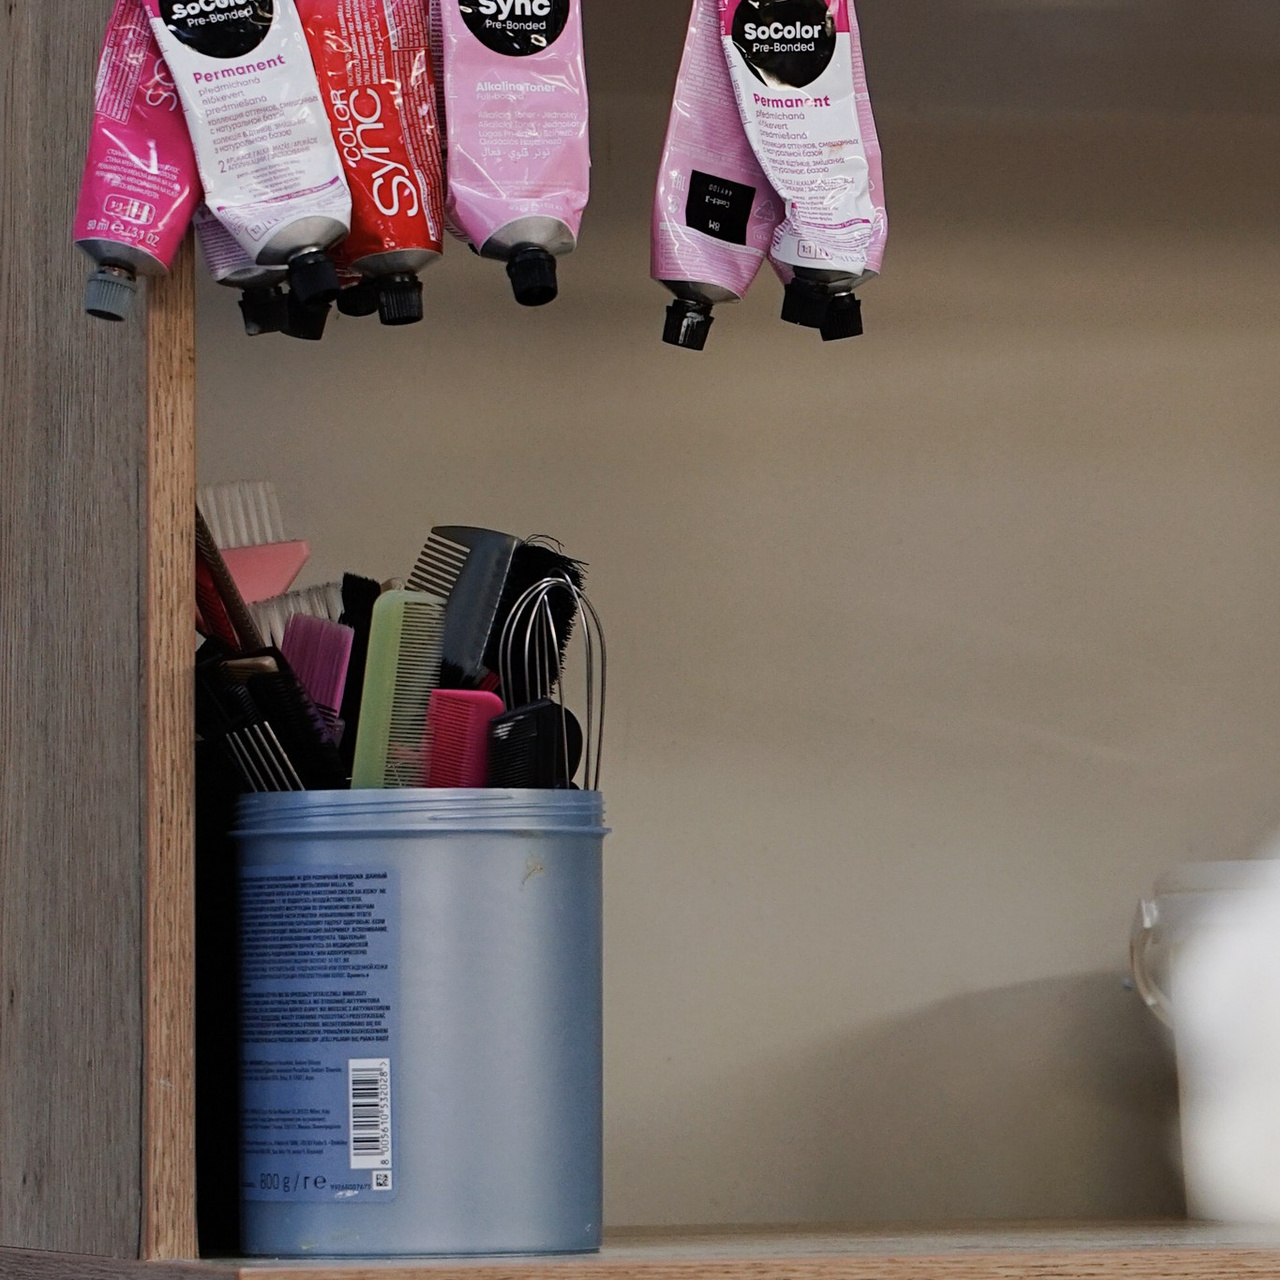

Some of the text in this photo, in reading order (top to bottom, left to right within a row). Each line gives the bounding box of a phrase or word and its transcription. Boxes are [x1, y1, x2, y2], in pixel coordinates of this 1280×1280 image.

[485, 19, 545, 31] Pre-Bonded
[745, 23, 821, 40] SoColor
[753, 41, 814, 53] Pre-Bonded
[193, 54, 285, 84] Permanent
[199, 77, 260, 96] předmichaná
[476, 82, 556, 92] Alkaline Toner
[331, 89, 361, 169] COLOR
[350, 88, 419, 217] Sync
[709, 184, 733, 196] 44Y100
[709, 220, 720, 230] 8M
[380, 1071, 389, 1109] 532028
[381, 1113, 390, 1152] 005610
[260, 1173, 290, 1192] 800 g
